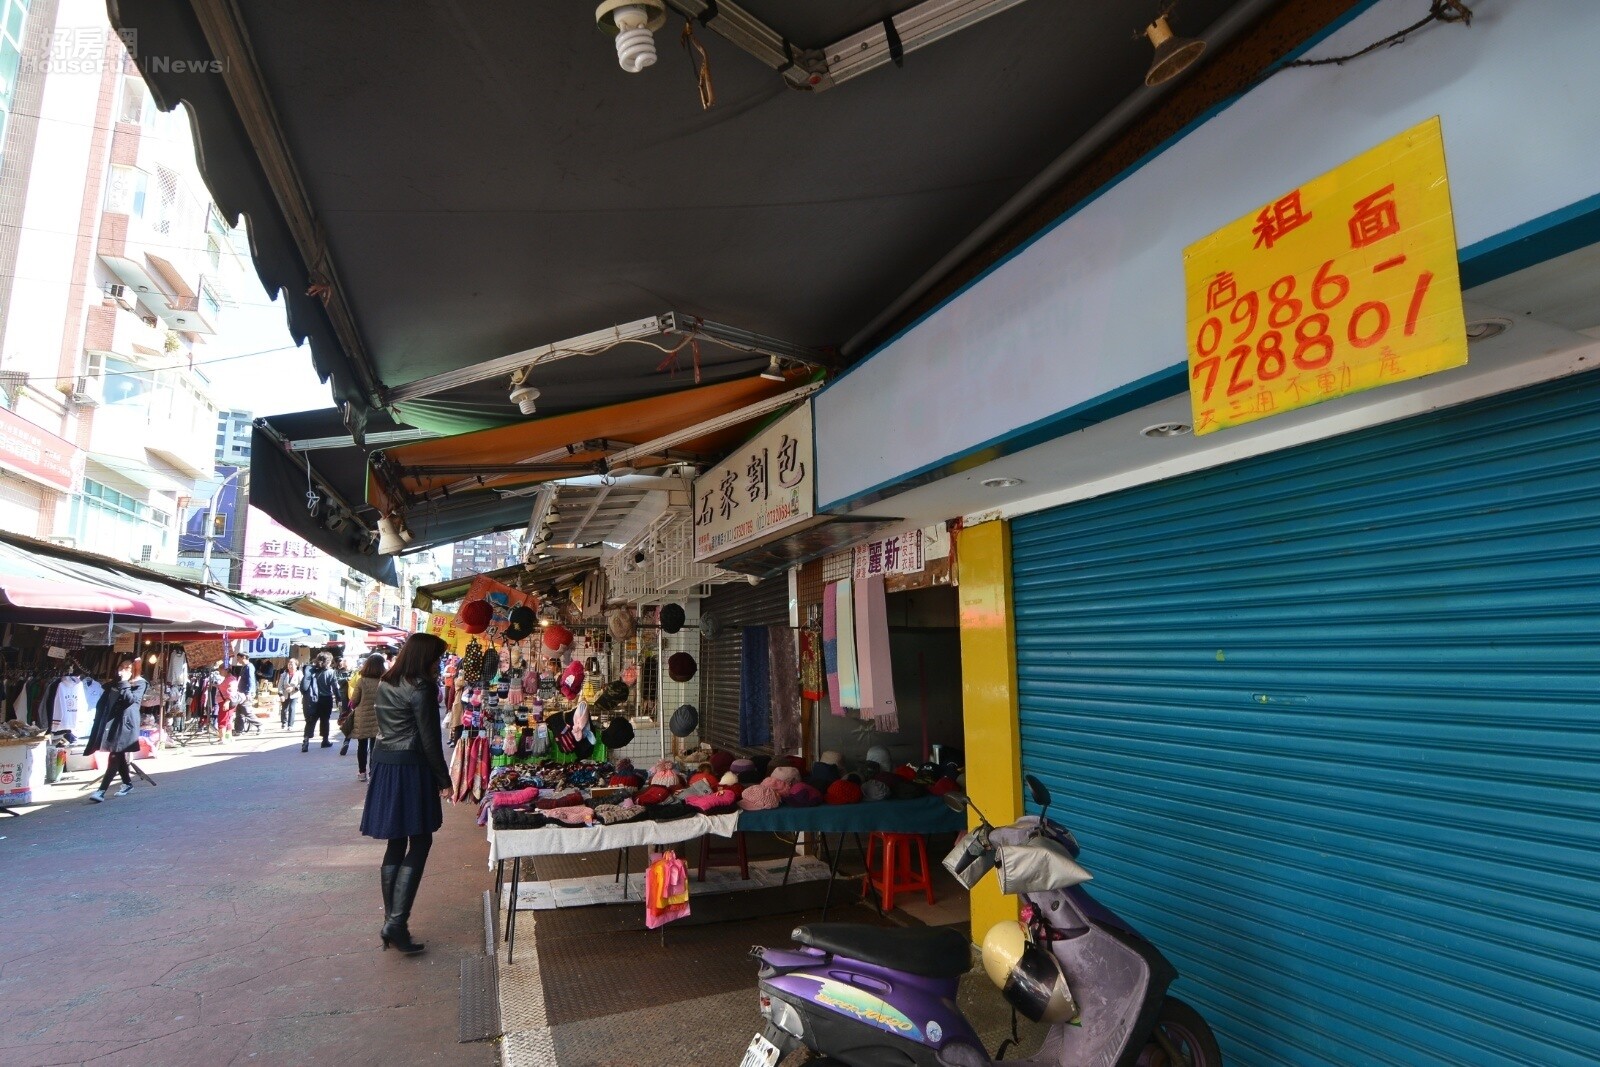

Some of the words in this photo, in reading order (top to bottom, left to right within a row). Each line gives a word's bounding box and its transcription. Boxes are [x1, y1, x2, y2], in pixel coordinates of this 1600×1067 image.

[1252, 189, 1313, 250] 租
[1349, 183, 1400, 248] 面
[1206, 270, 1237, 313] 店
[1193, 269, 1434, 404] 728801
[696, 434, 805, 526] 石家割包
